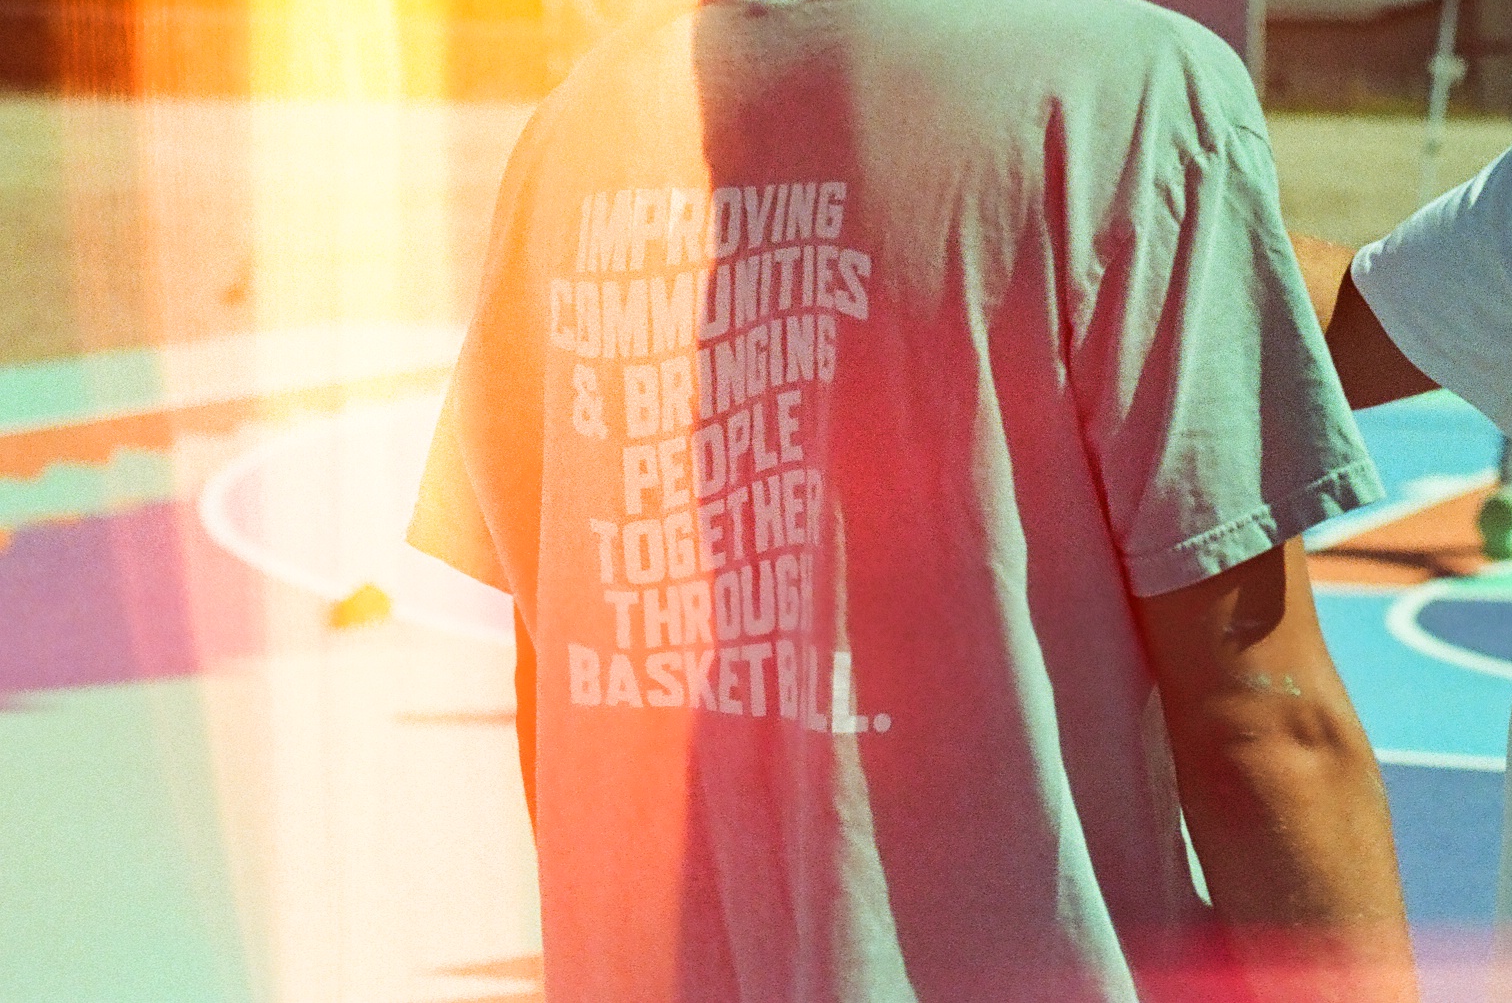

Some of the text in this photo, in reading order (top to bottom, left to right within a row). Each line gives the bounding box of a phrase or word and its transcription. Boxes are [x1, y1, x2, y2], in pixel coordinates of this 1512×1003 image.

[576, 182, 848, 273] IMPROVING
[549, 245, 872, 359] COMMUNITIES
[572, 314, 838, 439] & BRINGING
[621, 389, 803, 516] PEOPLE
[590, 467, 825, 586] TOGETHER
